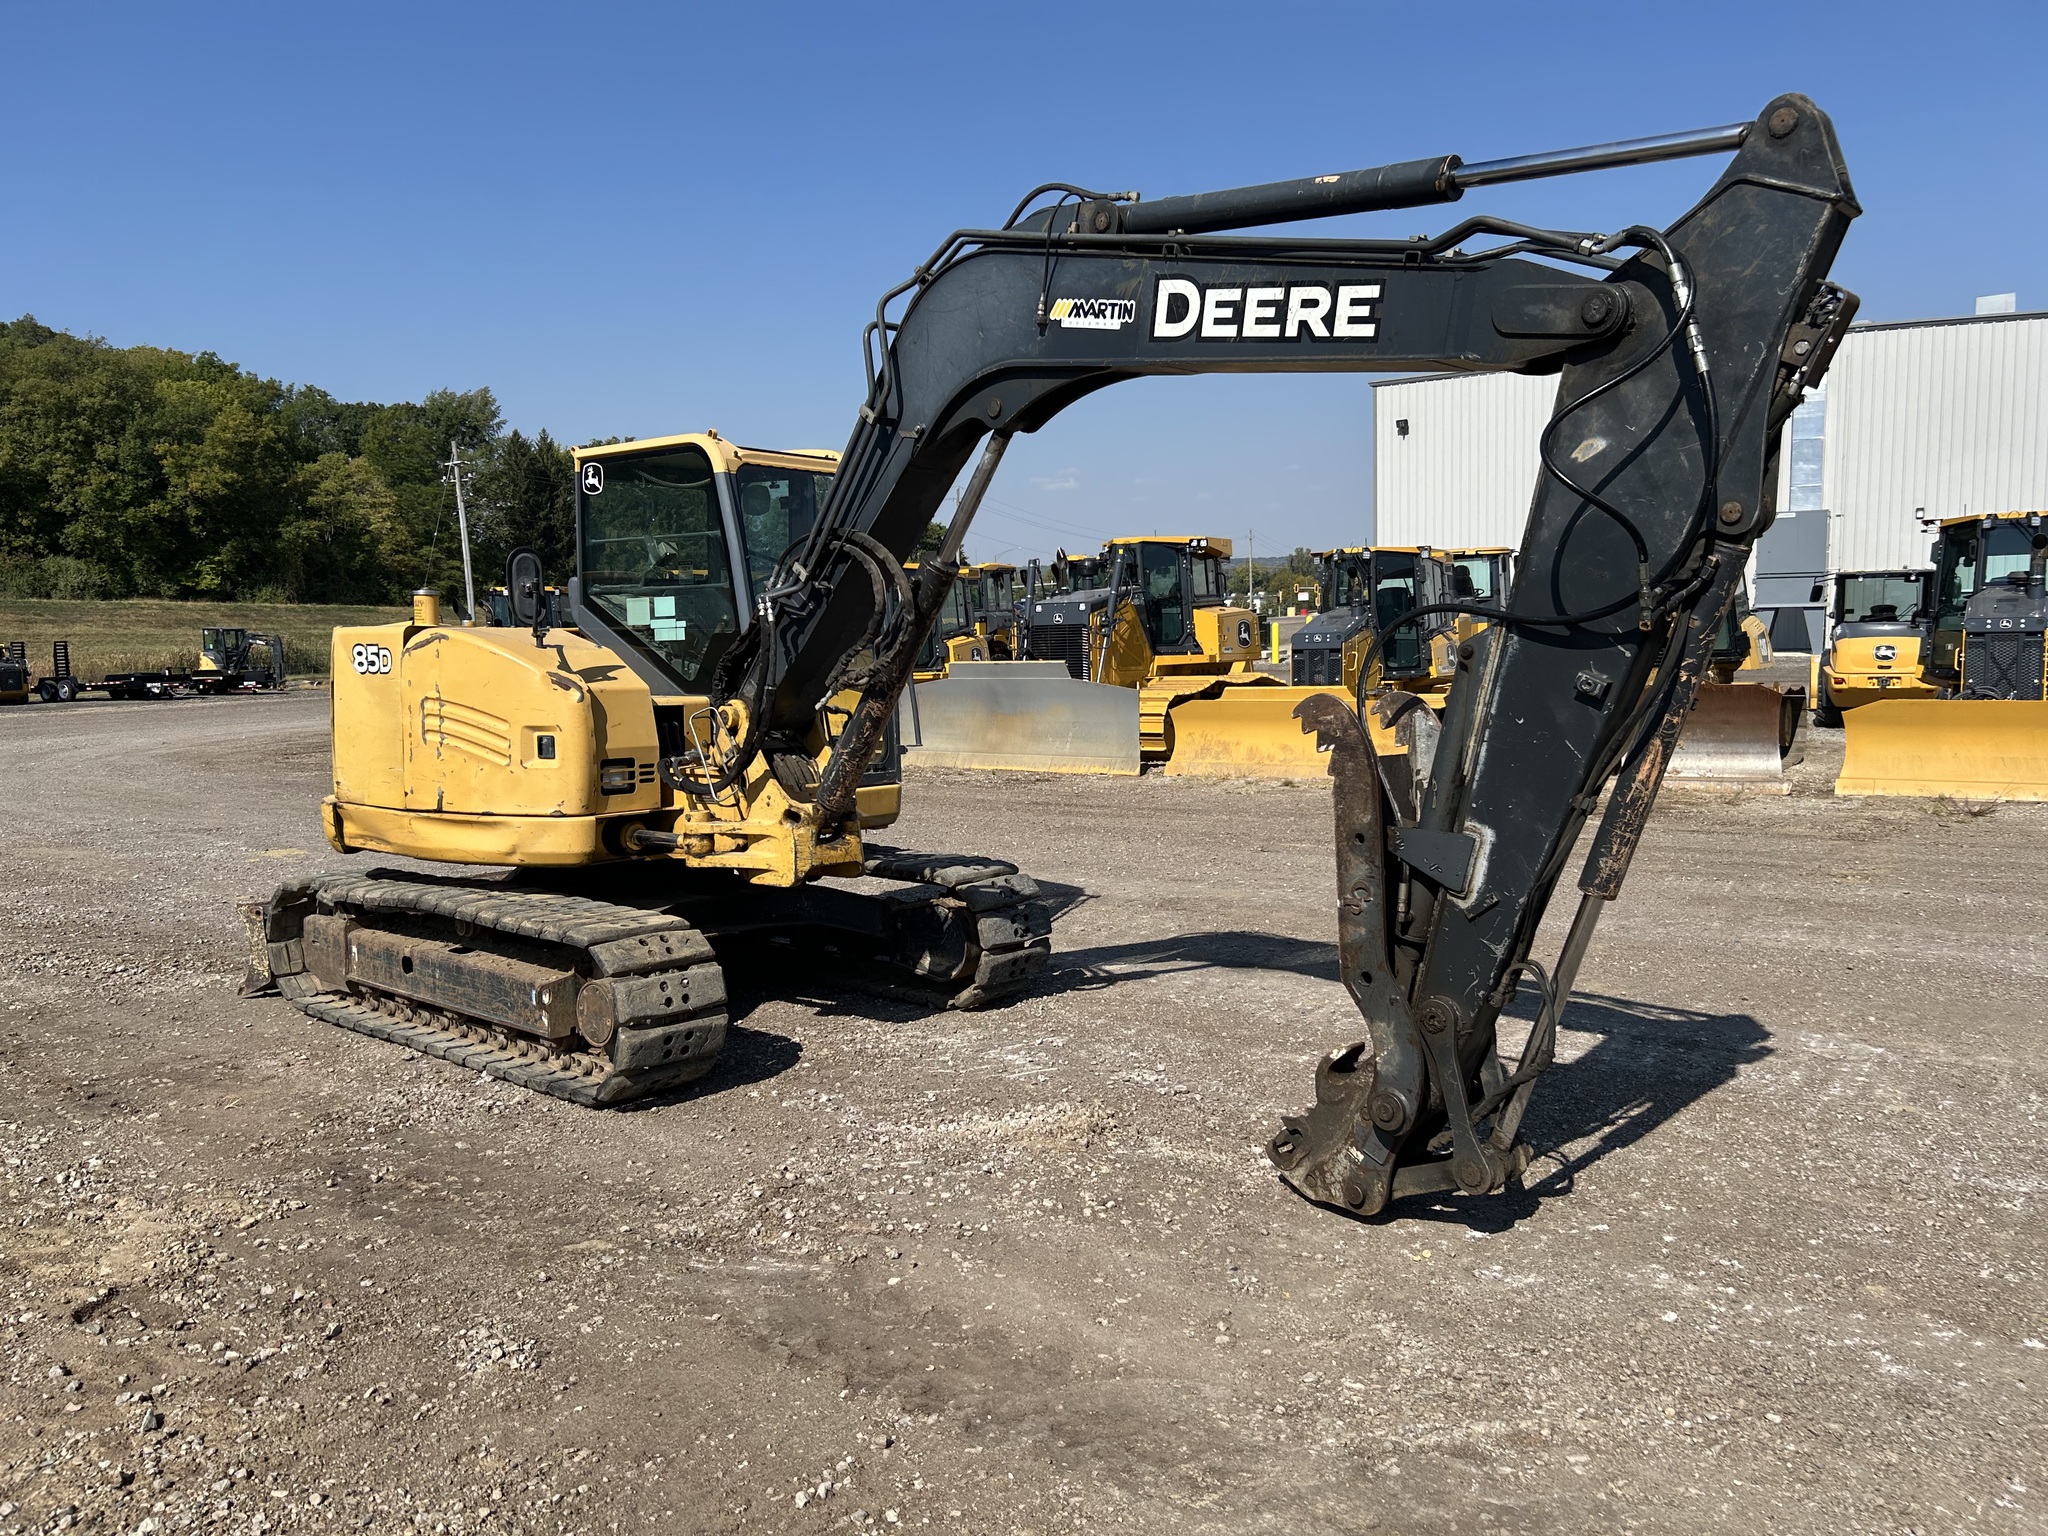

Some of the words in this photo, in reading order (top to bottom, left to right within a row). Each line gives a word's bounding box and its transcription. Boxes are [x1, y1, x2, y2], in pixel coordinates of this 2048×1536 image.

[1067, 300, 1134, 320] MARTIN
[1153, 279, 1381, 338] DEERE
[352, 643, 393, 675] 85D
